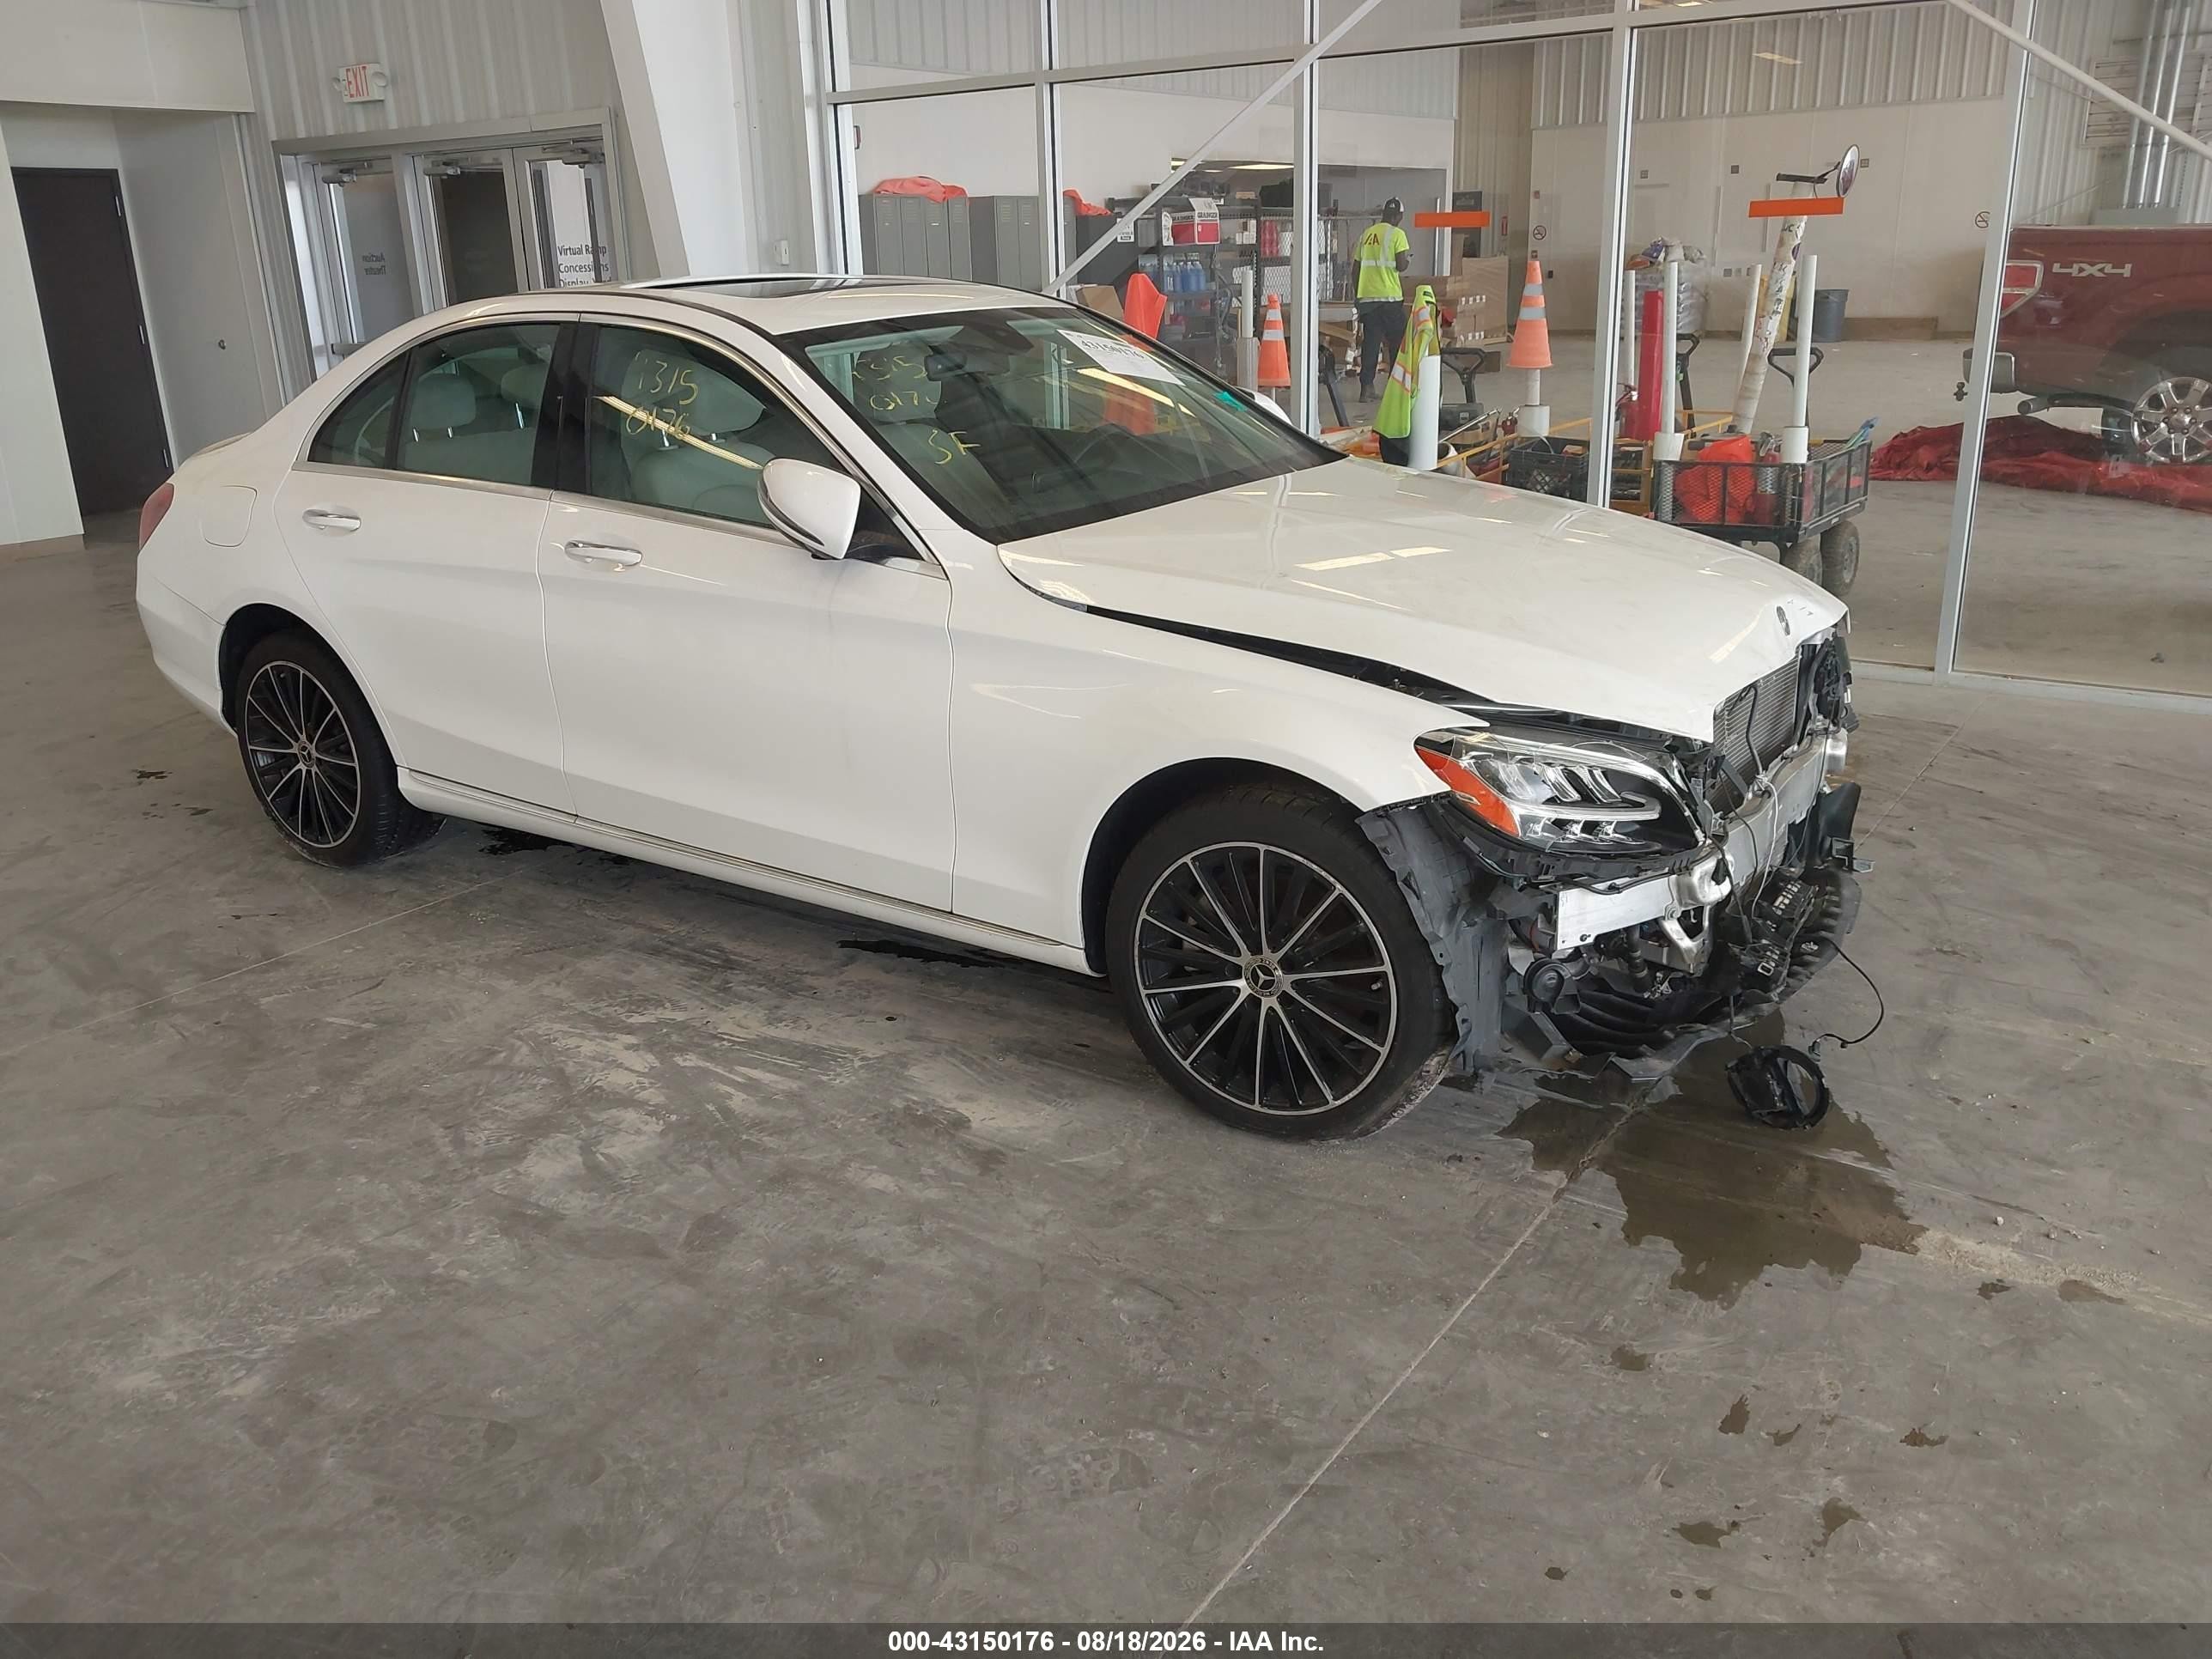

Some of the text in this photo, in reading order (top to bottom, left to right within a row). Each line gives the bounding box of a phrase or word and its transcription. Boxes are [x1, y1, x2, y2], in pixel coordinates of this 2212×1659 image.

[345, 66, 369, 98] EXIT
[557, 244, 607, 257] Virtual Rap
[558, 261, 609, 273] Concessins
